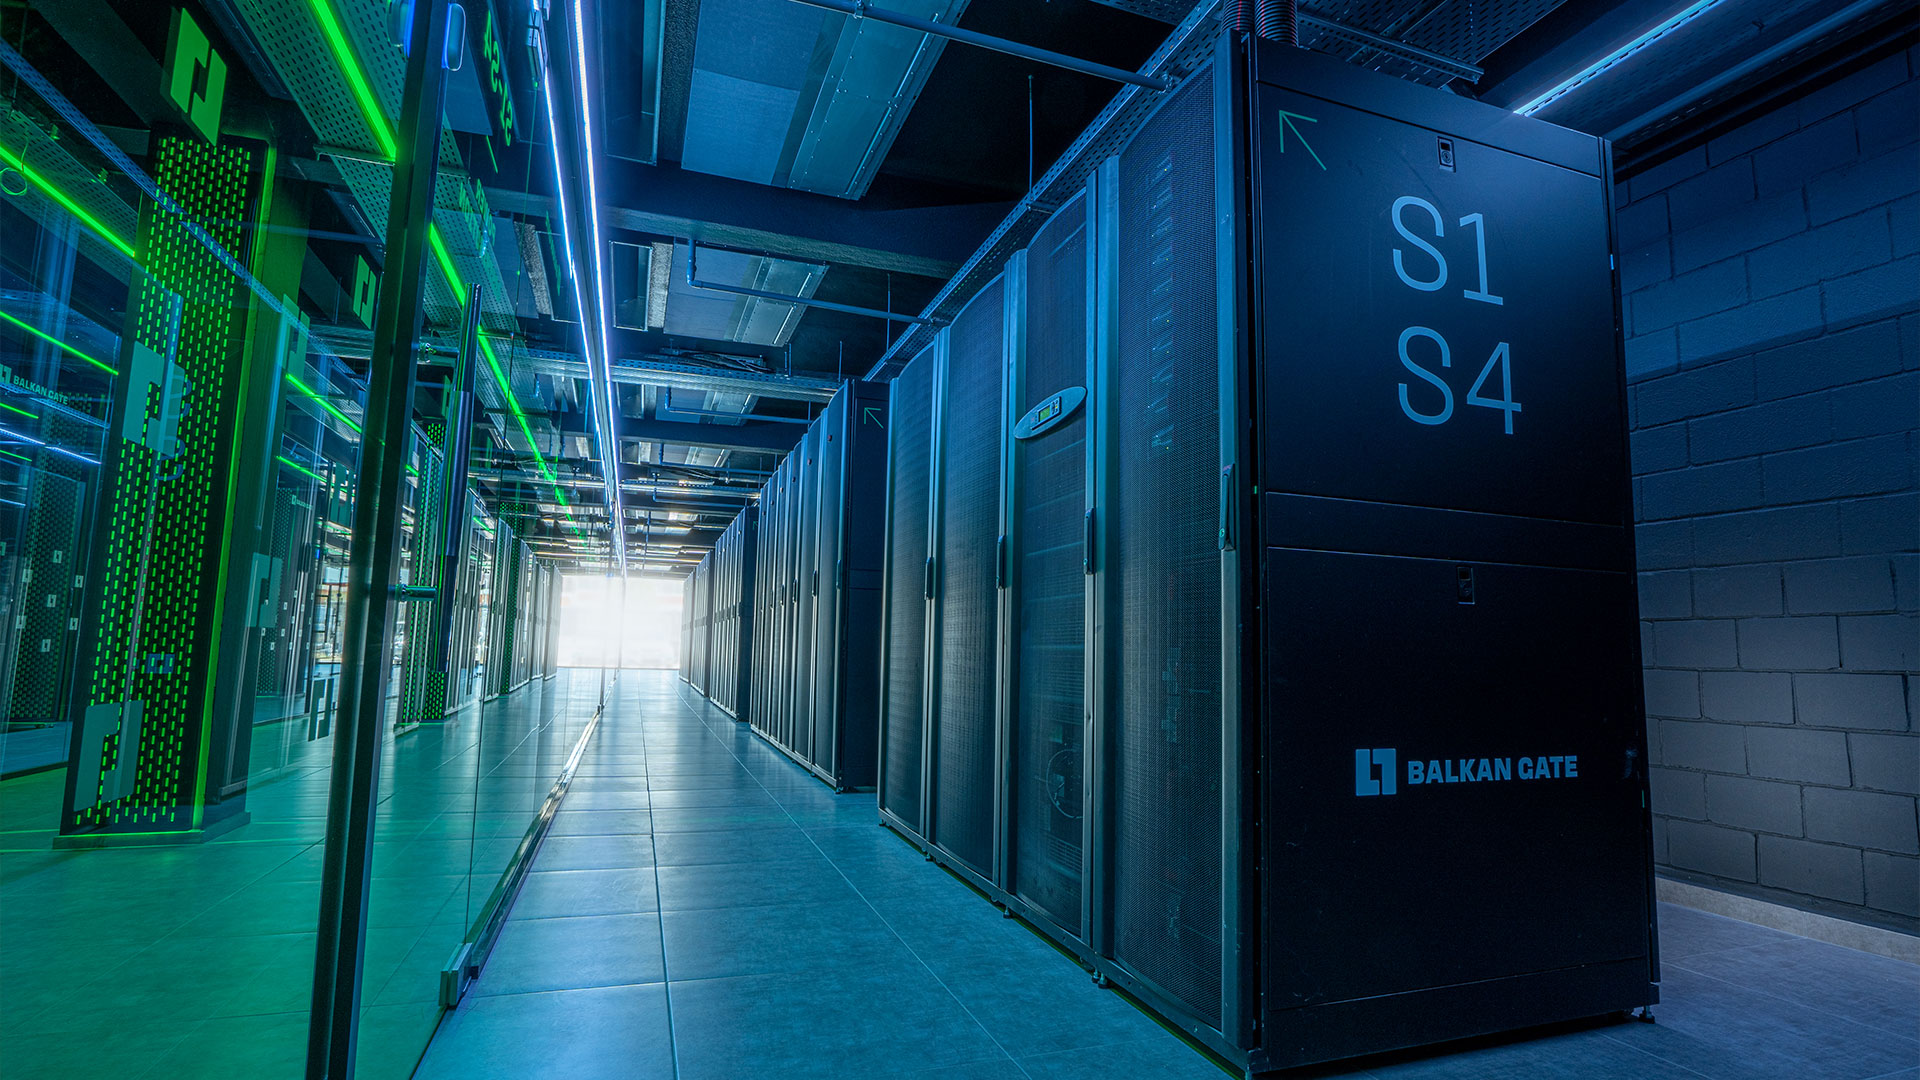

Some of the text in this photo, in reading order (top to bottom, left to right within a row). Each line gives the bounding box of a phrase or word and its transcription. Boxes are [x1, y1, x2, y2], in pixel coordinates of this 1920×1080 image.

[1391, 196, 1504, 305] S1
[13, 375, 47, 396] BALKAN
[1398, 326, 1522, 434] S4
[1408, 755, 1578, 784] BALKAN GATE
